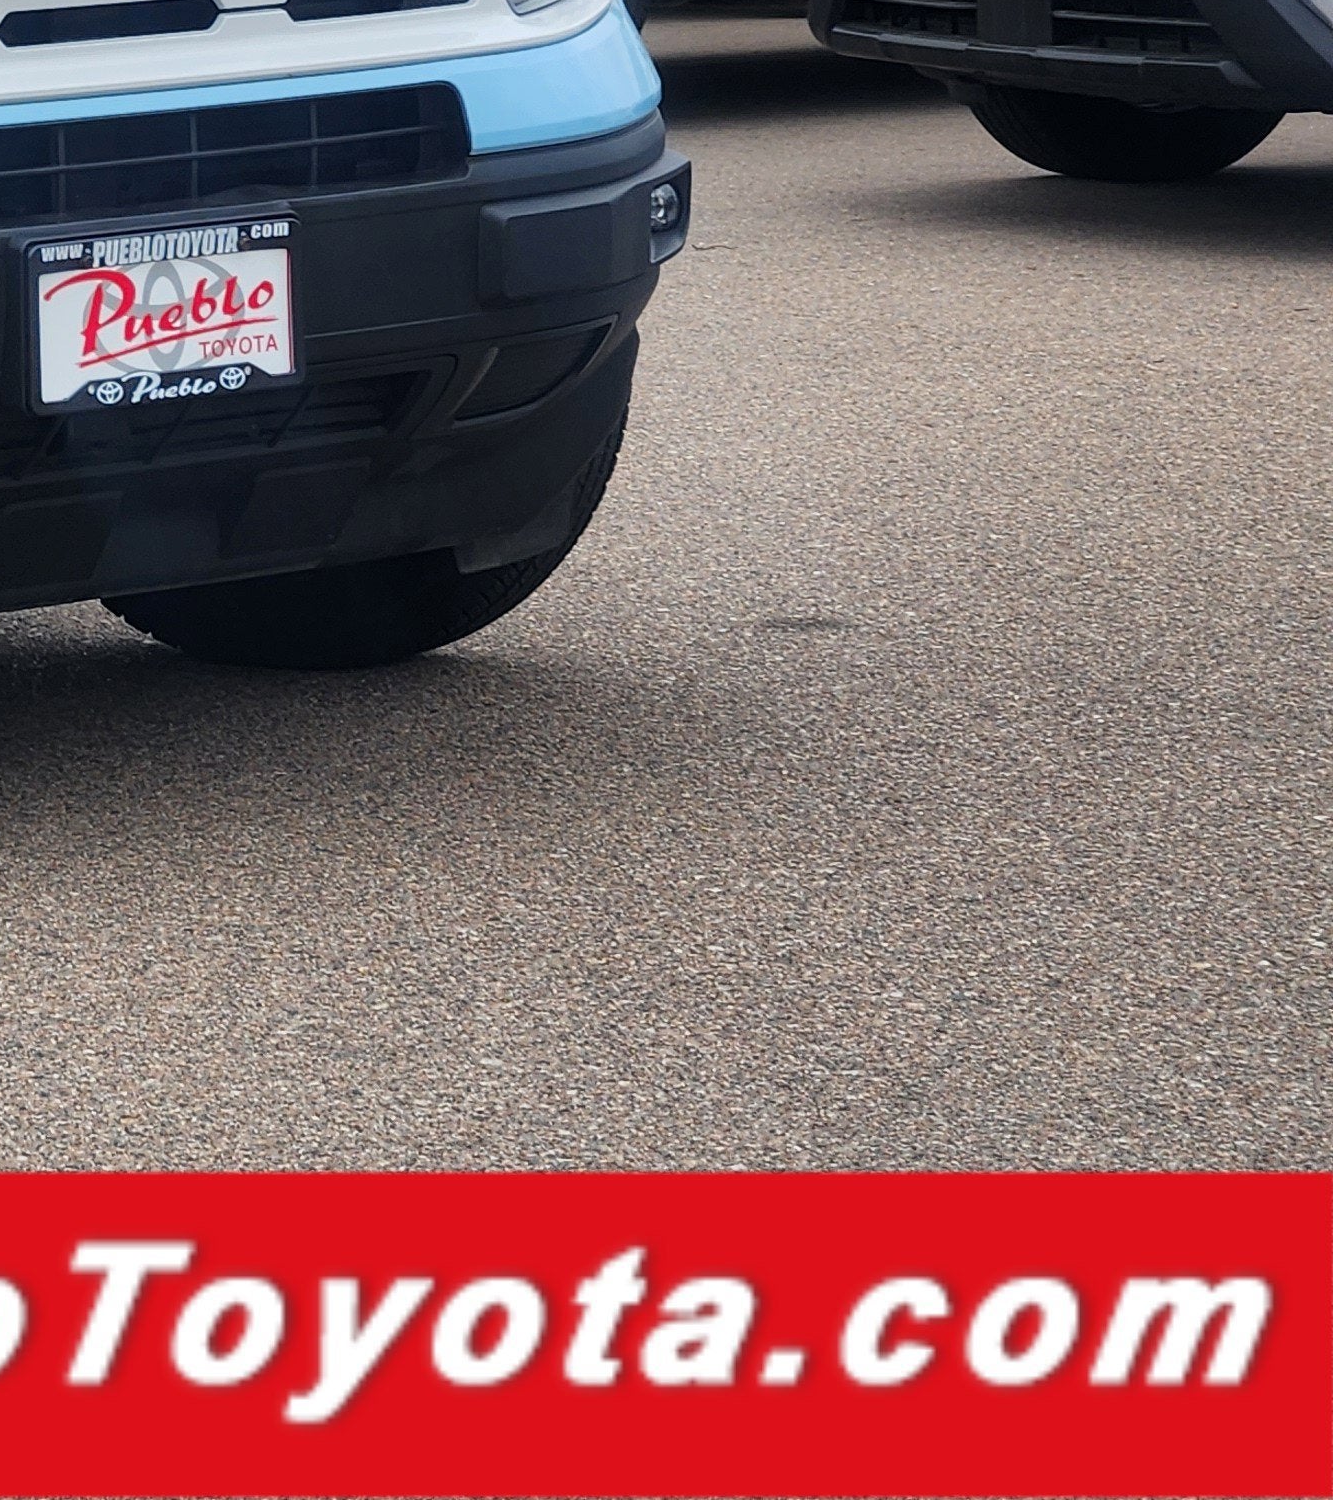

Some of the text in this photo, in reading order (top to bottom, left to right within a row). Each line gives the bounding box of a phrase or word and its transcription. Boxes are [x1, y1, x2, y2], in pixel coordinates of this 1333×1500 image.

[43, 268, 275, 357] Pueblo
[198, 333, 279, 359] TOYOTA
[121, 371, 217, 404] Pueblo
